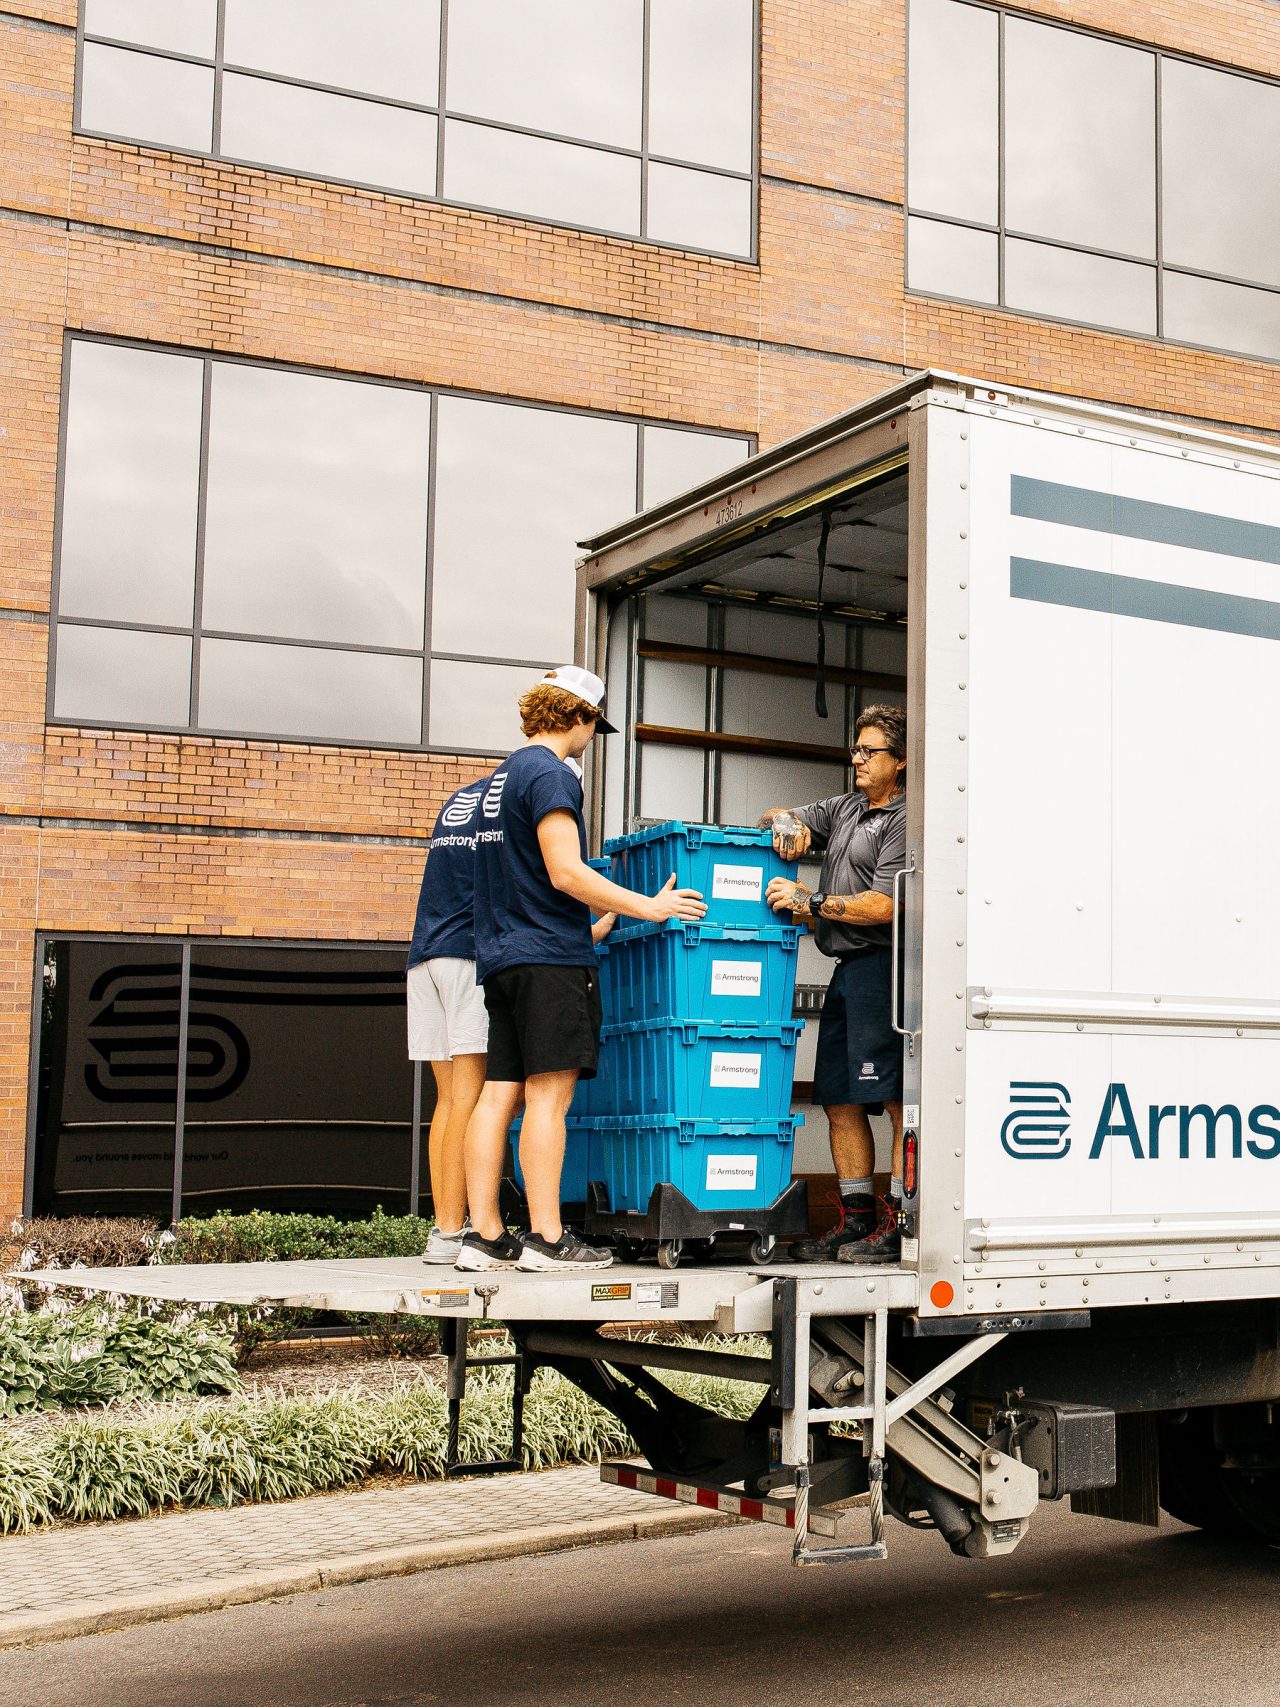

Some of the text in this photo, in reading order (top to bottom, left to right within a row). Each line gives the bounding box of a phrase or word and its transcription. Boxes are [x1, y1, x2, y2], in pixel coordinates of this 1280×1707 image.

[716, 500, 743, 525] 473612
[723, 878, 760, 888] Armstrong
[722, 973, 759, 983] Armstrong
[721, 1065, 758, 1075] Armstrong
[717, 1168, 754, 1176] Armstrong
[595, 1287, 629, 1295] MAXGRIP
